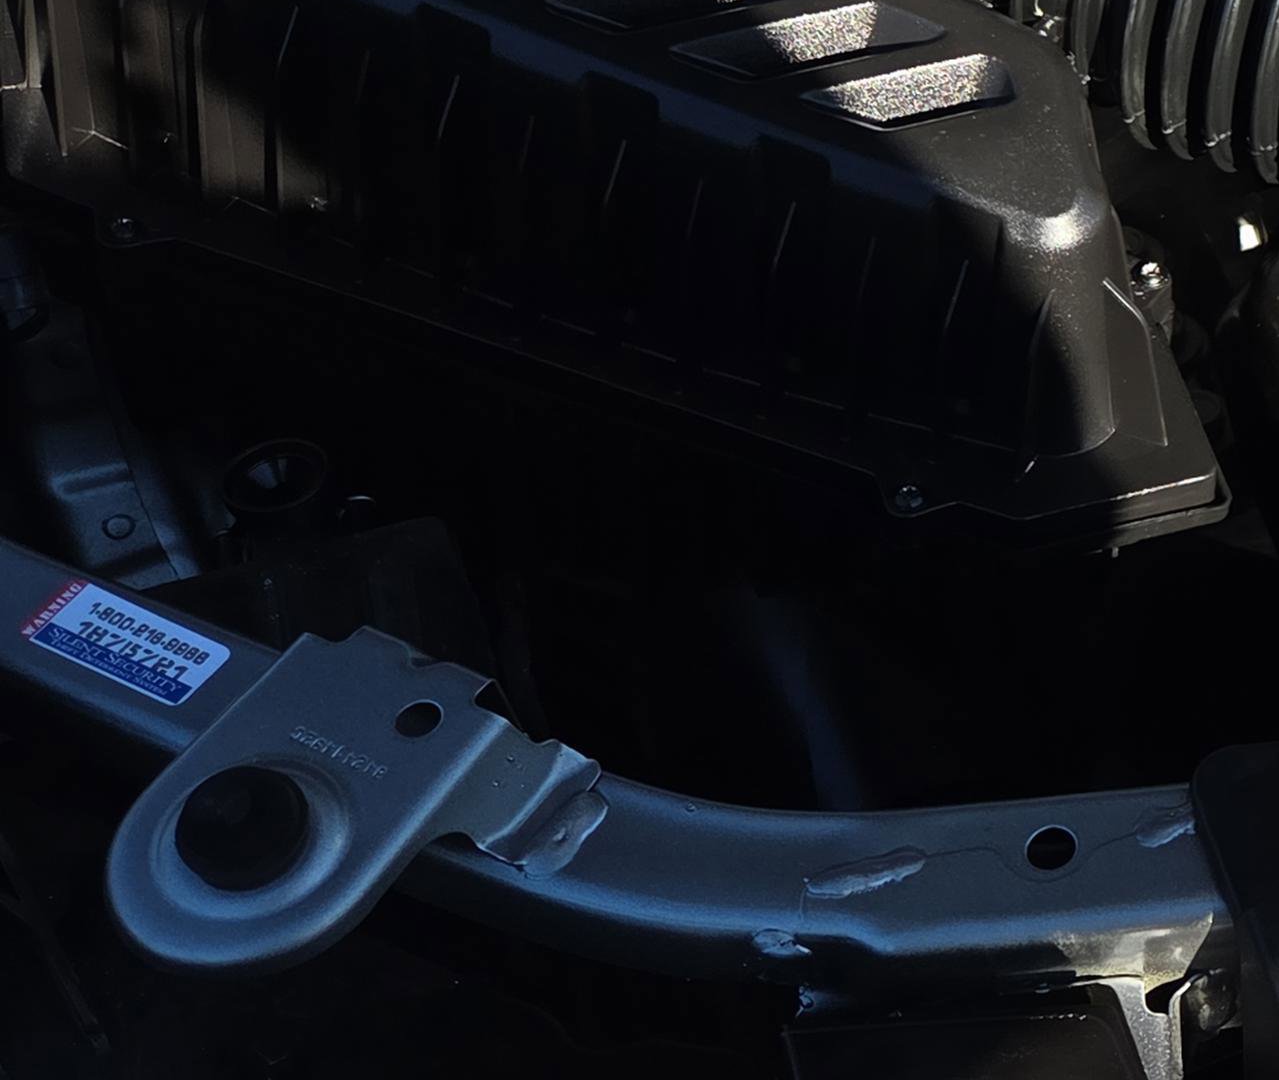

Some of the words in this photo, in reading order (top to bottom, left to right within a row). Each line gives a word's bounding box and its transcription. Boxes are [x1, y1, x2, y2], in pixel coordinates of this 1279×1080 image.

[21, 583, 82, 635] WARNING
[47, 626, 106, 659] SILENT
[104, 651, 182, 692] SECURITY
